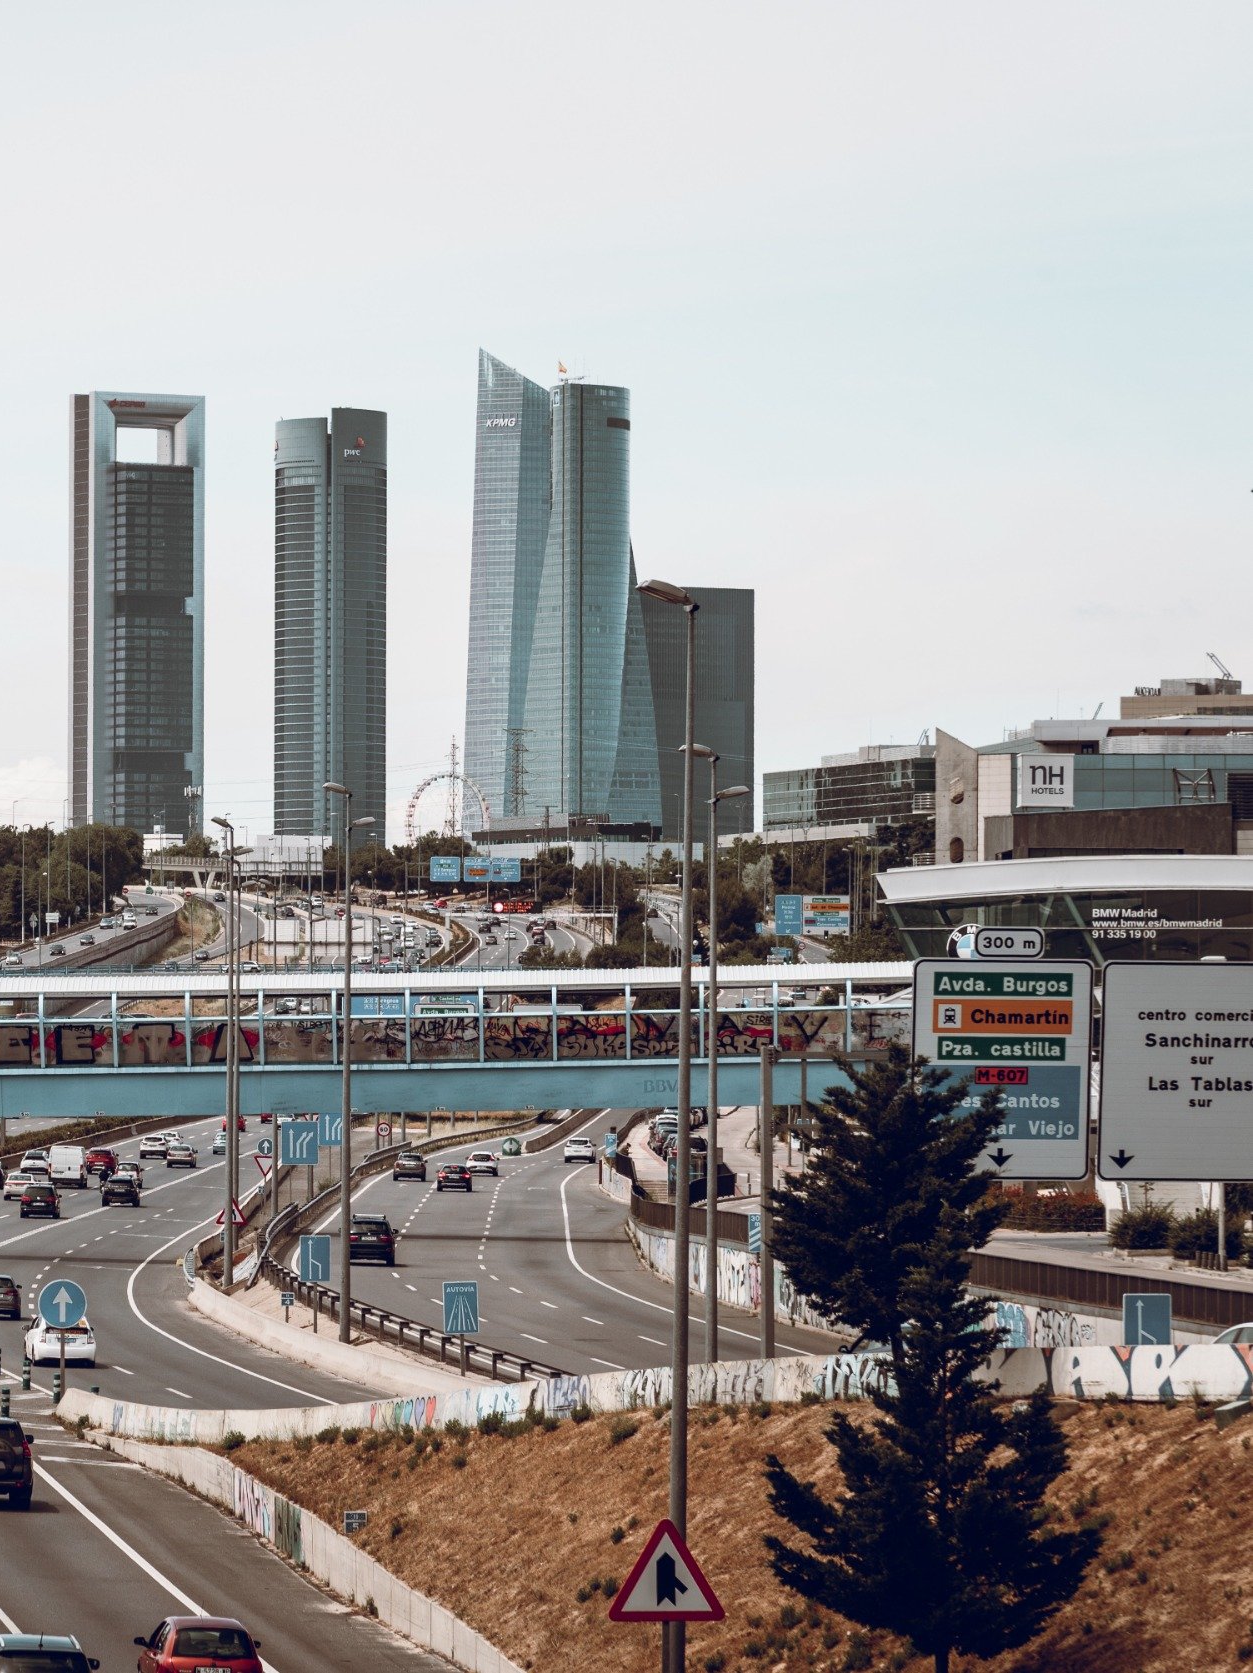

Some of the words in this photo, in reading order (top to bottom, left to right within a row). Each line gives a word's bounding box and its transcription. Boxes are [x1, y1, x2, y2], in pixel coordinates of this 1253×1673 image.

[486, 418, 516, 428] KPMG
[1031, 787, 1065, 795] HOTELS
[1092, 908, 1120, 918] BMW
[1121, 908, 1158, 918] Madrid
[1092, 918, 1223, 928] www.bmw.es/bmwmadrid
[1092, 930, 1104, 938] 91
[1107, 930, 1126, 938] 335
[1129, 930, 1141, 938] 19
[1143, 930, 1157, 938] 00
[983, 937, 1014, 949] 300
[1023, 940, 1036, 949] m
[938, 976, 991, 992] Avda.
[1003, 976, 1068, 995] Burgos
[971, 1008, 1069, 1025] Chamartín
[1138, 1009, 1187, 1021] centro
[942, 1041, 979, 1056] Pza.
[990, 1041, 1061, 1057] castilla
[1190, 1056, 1214, 1065] sur
[977, 1069, 1026, 1082] M-607
[1149, 1076, 1179, 1091] Las
[1191, 1076, 1253, 1091] Tablas
[1189, 1098, 1213, 1107] sur
[1028, 1120, 1075, 1138] Viejo
